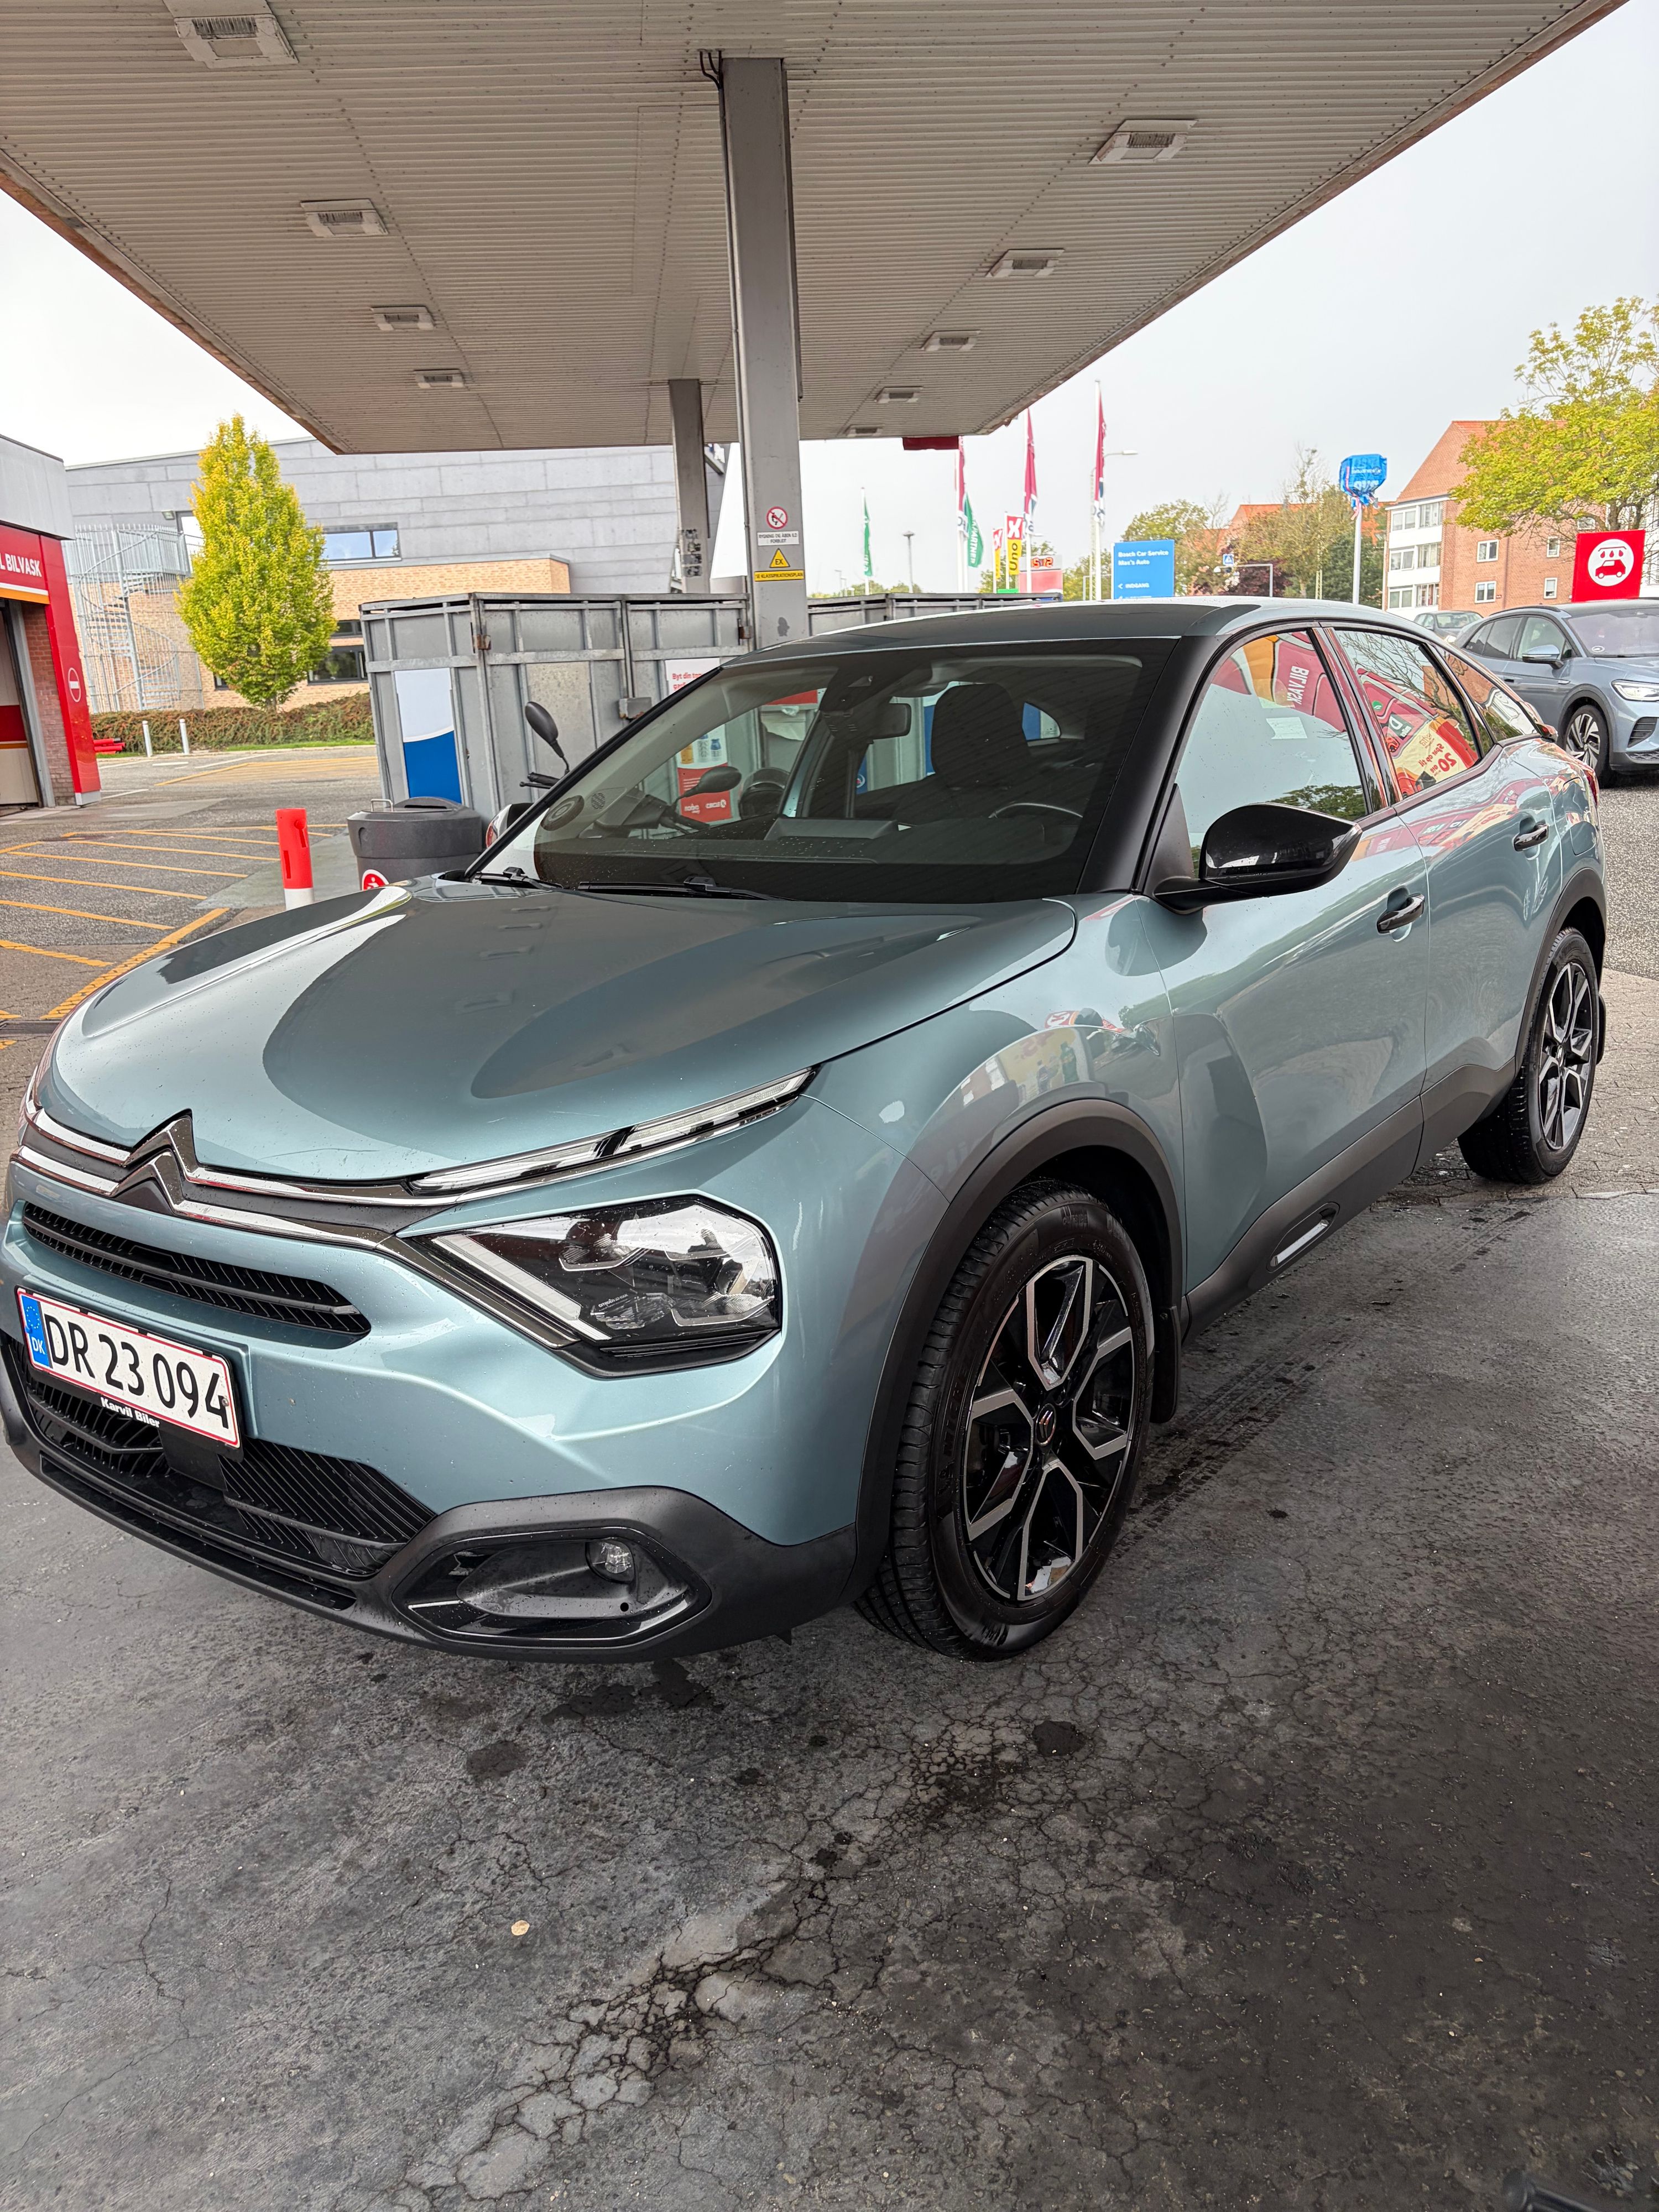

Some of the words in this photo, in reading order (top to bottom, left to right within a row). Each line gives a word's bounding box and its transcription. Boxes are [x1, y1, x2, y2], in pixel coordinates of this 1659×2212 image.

[5, 553, 43, 577] BILVASK
[1009, 542, 1019, 571] Uno
[31, 1335, 46, 1355] DK
[44, 1313, 96, 1379] DR
[98, 1333, 145, 1396] 23
[153, 1353, 229, 1429] 094
[100, 1396, 133, 1418] Karvil
[134, 1410, 160, 1428] Biler
